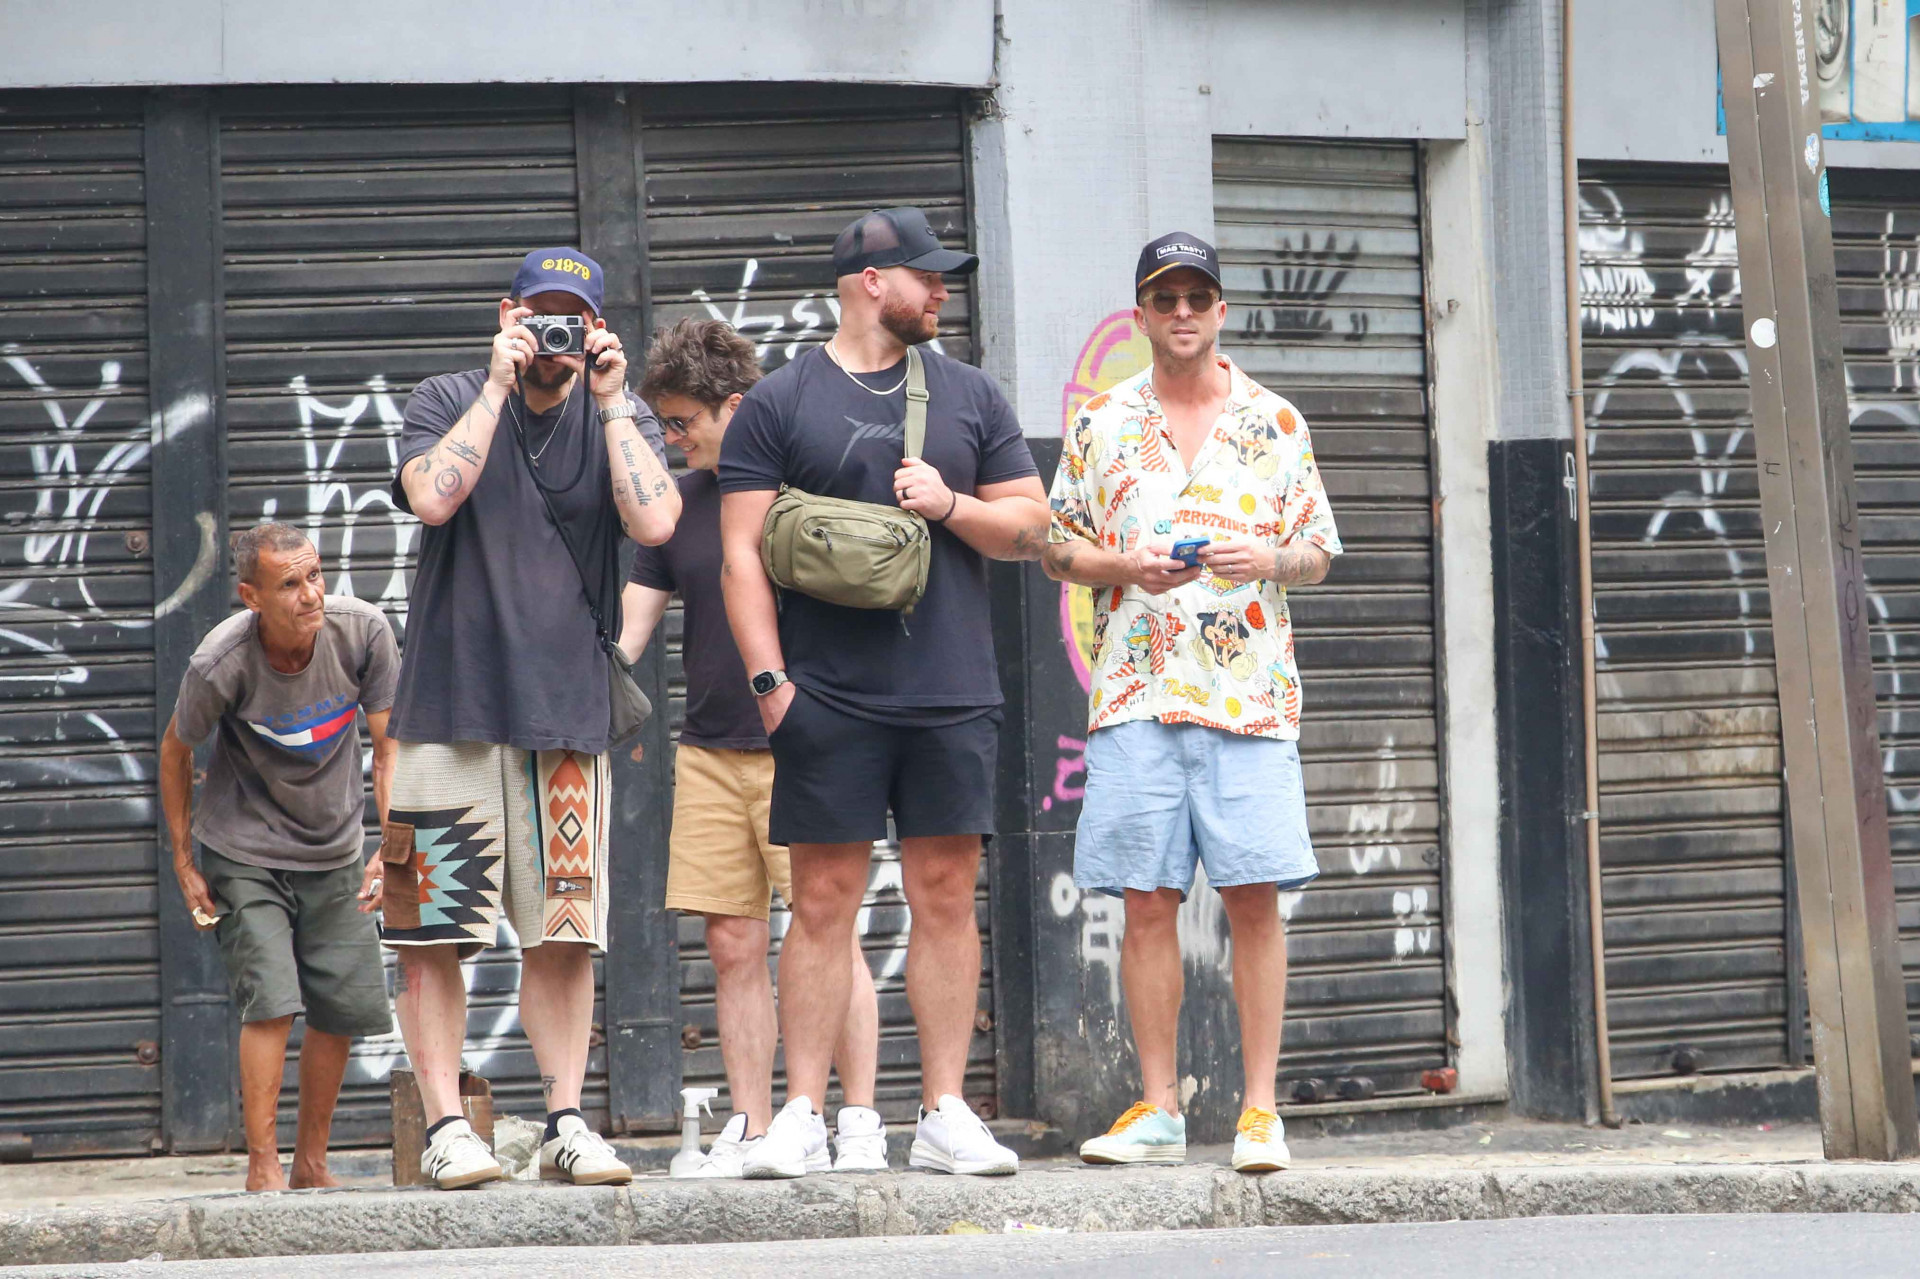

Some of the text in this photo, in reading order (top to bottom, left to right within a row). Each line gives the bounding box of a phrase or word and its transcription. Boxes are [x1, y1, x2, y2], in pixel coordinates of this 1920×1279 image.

[1159, 245, 1203, 255] MAD TASTY
[1172, 508, 1249, 535] VERYTHING
[264, 692, 346, 725] TOMMY
[1107, 679, 1149, 714] COOL
